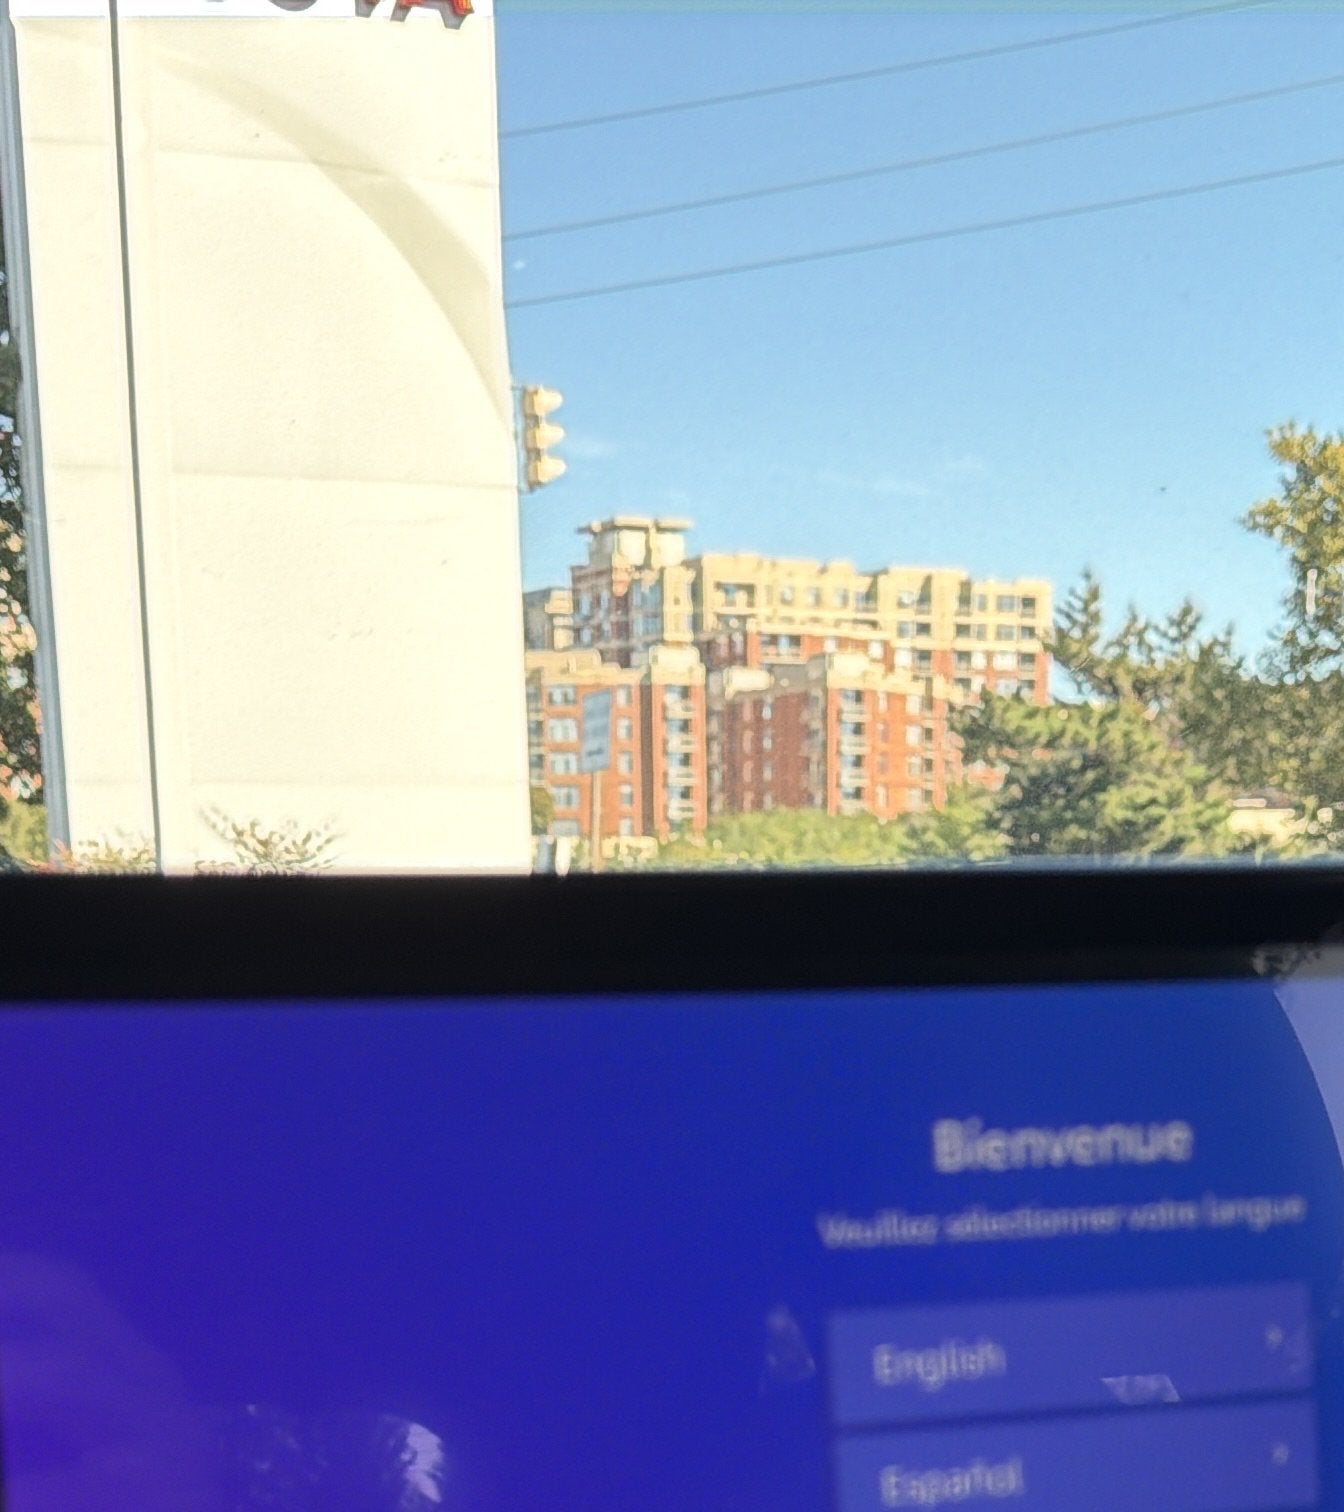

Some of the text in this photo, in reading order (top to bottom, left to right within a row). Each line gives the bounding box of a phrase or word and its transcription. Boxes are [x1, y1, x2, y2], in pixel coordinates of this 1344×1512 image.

[933, 1116, 1194, 1172] Bienvenue
[872, 1336, 1006, 1390] English
[879, 1458, 1024, 1509] Español
